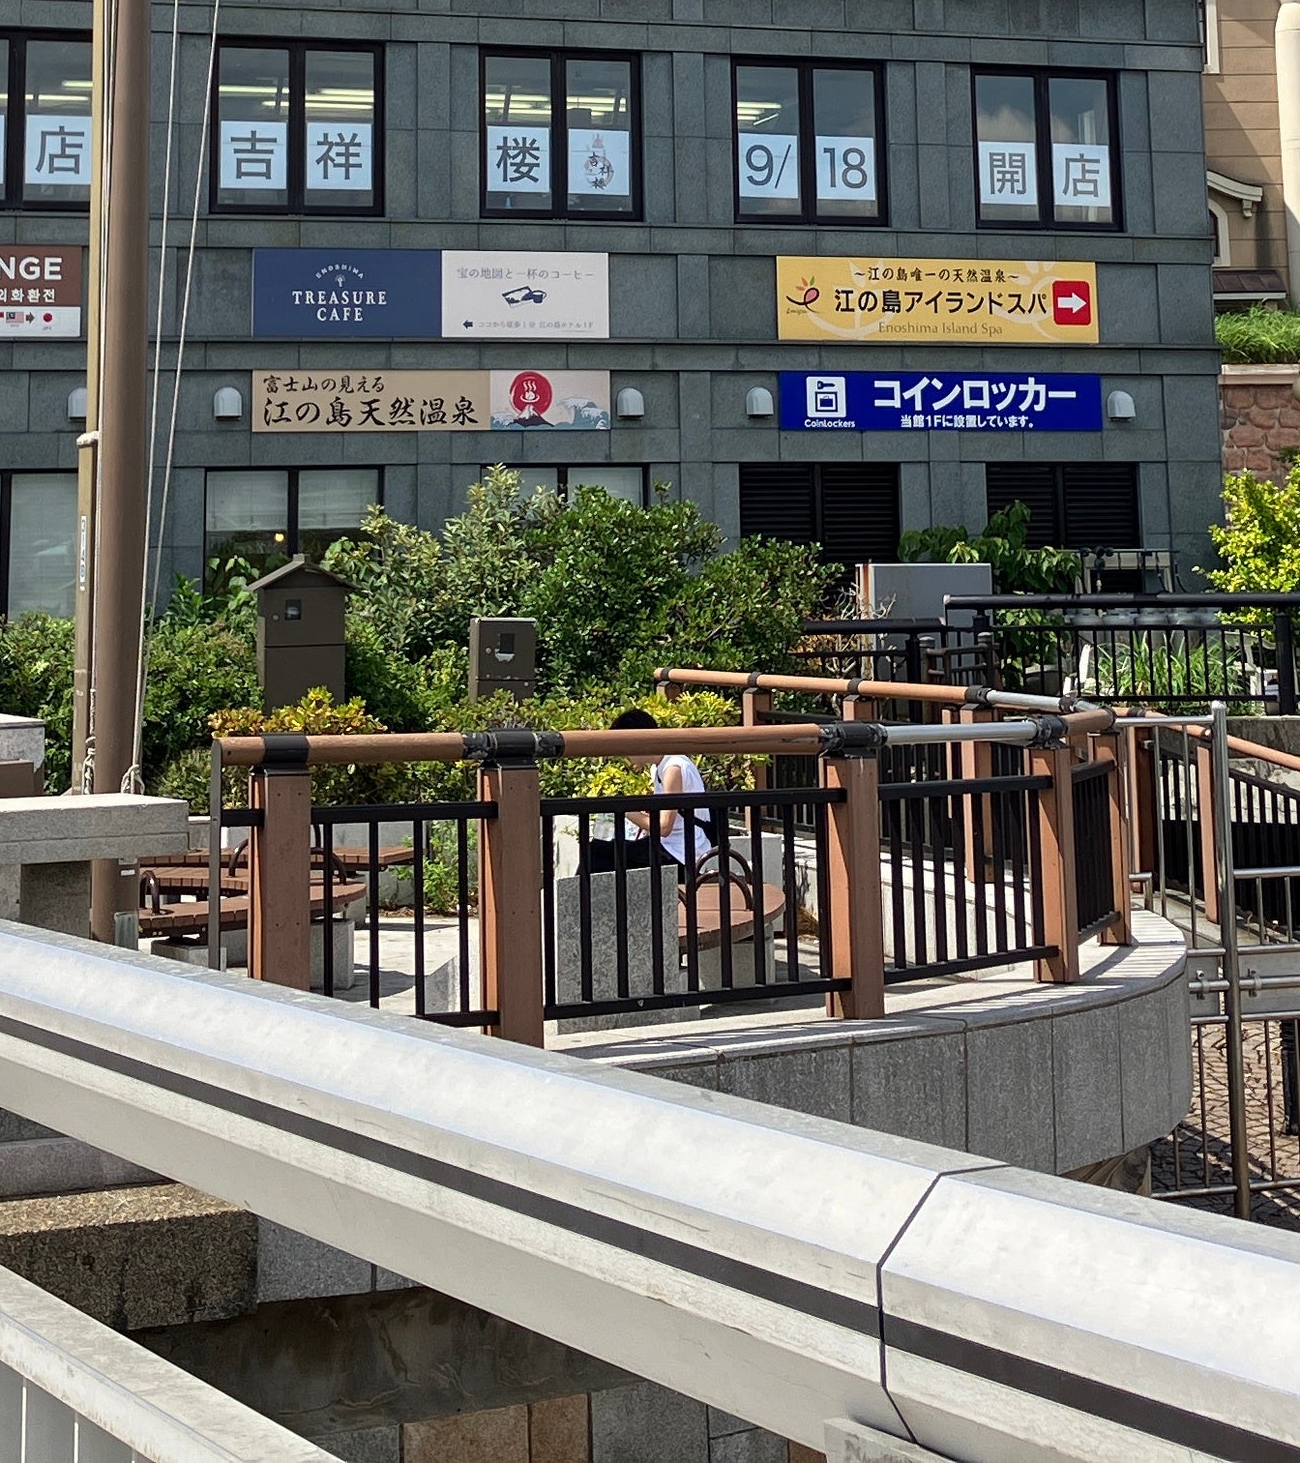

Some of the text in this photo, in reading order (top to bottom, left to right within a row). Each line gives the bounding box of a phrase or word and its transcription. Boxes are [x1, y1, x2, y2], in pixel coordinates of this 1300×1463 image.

[230, 130, 363, 181] 吉祥
[496, 136, 541, 184] 楼
[745, 143, 868, 190] 9/18
[988, 152, 1101, 199] 開店
[292, 290, 387, 305] TREASURE
[834, 289, 1048, 315] 江の島アイランドスパ
[316, 307, 364, 322] CAFE
[878, 321, 1003, 338] Enoshima Island Spa
[263, 375, 385, 394] 富士山の見える
[873, 376, 1077, 411] コインロッカー
[263, 396, 479, 427] 江の島天然温泉
[900, 414, 1035, 429] 当館1Fに設置しています。
